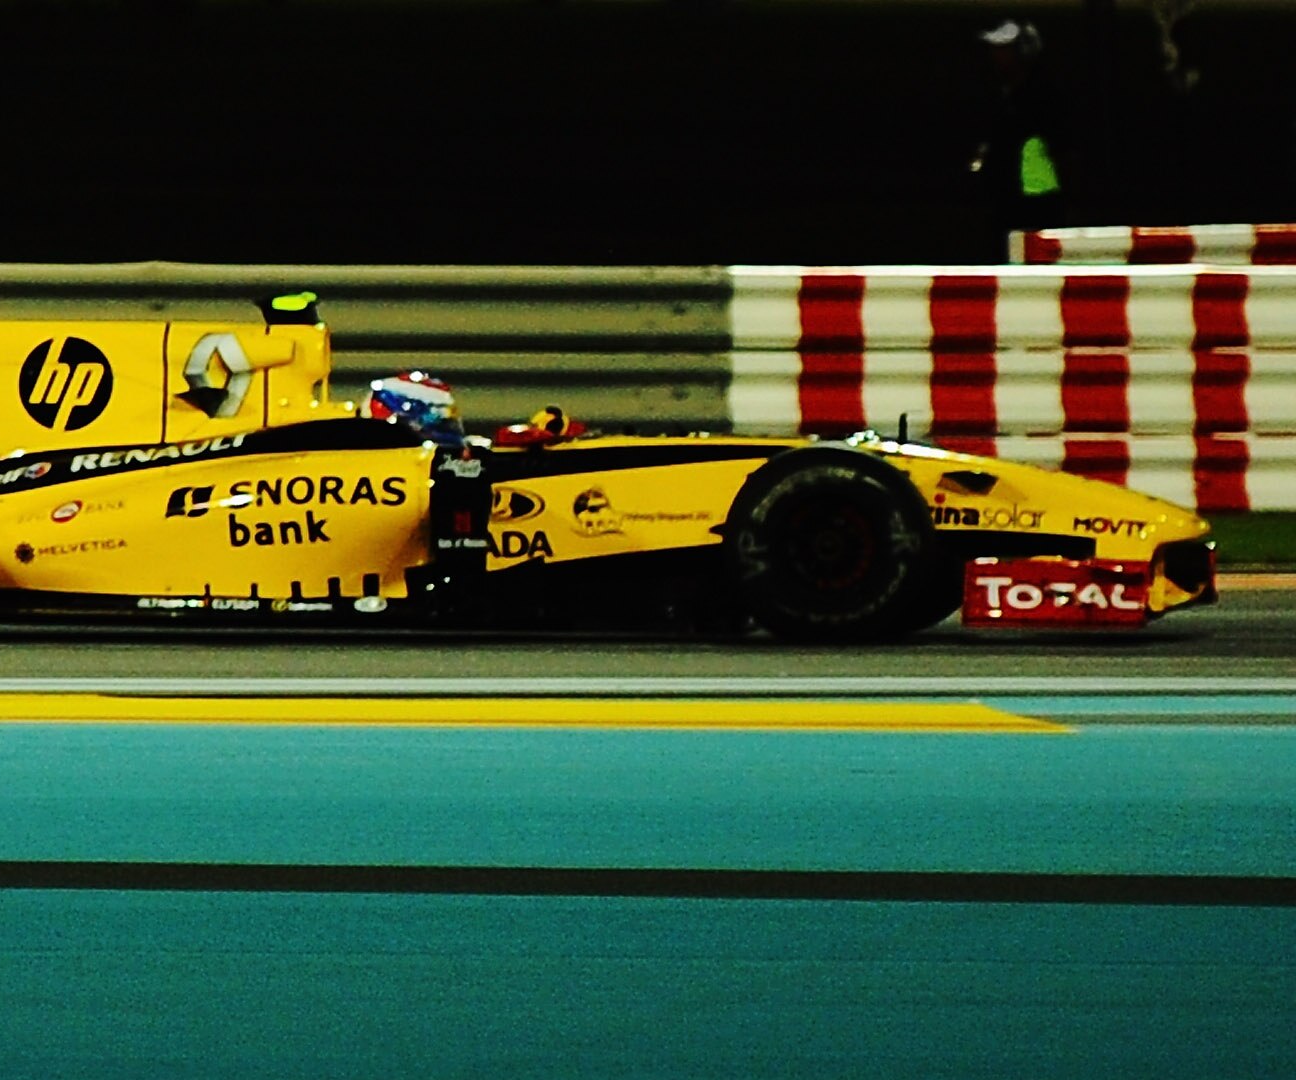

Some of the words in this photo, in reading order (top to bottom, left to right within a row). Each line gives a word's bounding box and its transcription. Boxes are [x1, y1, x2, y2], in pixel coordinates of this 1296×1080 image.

[28, 336, 105, 432] hp
[70, 432, 248, 473] RENAULT
[229, 476, 407, 508] SNORAS
[229, 510, 331, 547] bank
[488, 531, 554, 558] ADA
[975, 576, 1145, 610] TOTAL
